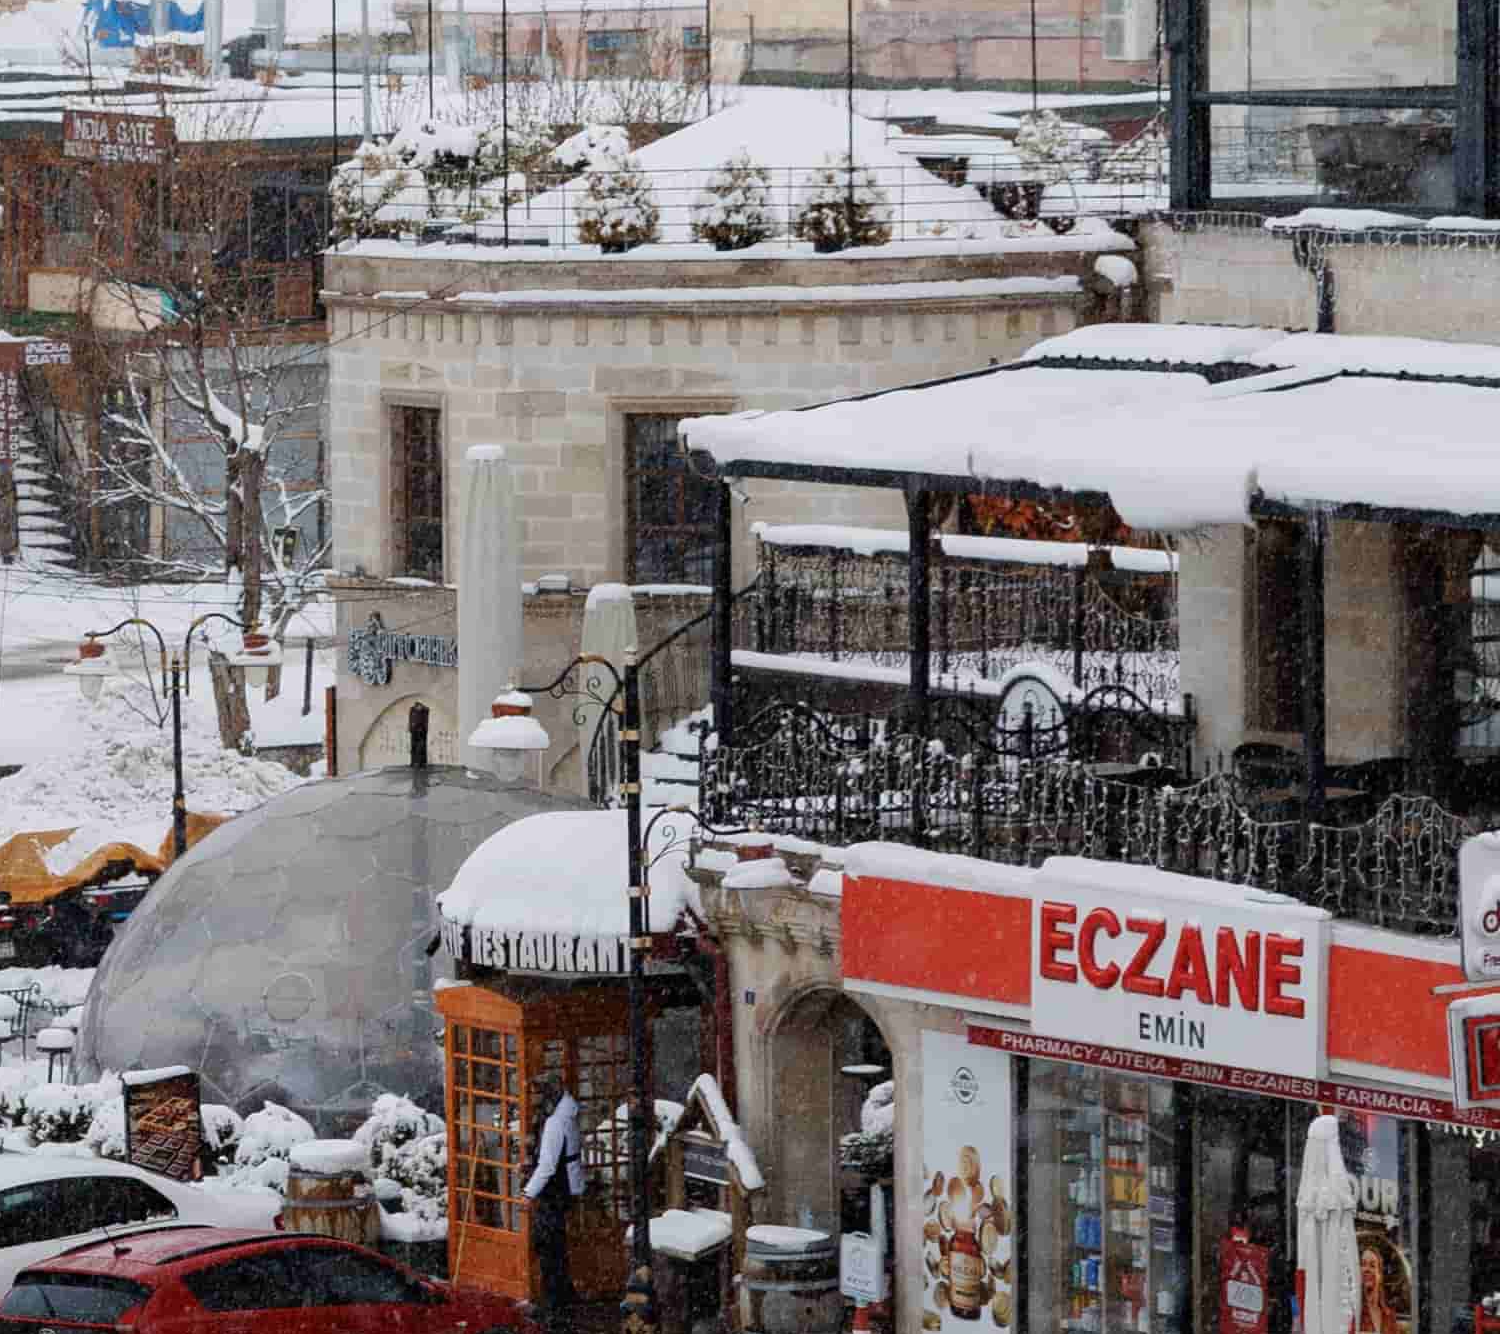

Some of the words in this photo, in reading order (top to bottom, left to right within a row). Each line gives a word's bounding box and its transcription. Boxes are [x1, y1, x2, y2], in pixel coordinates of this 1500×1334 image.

[117, 121, 156, 146] GATE
[471, 930, 632, 973] RESTAURANT
[1040, 900, 1305, 1019] ECZANE
[1139, 1010, 1205, 1050] EMİN
[1336, 1085, 1431, 1114] FARMACIA
